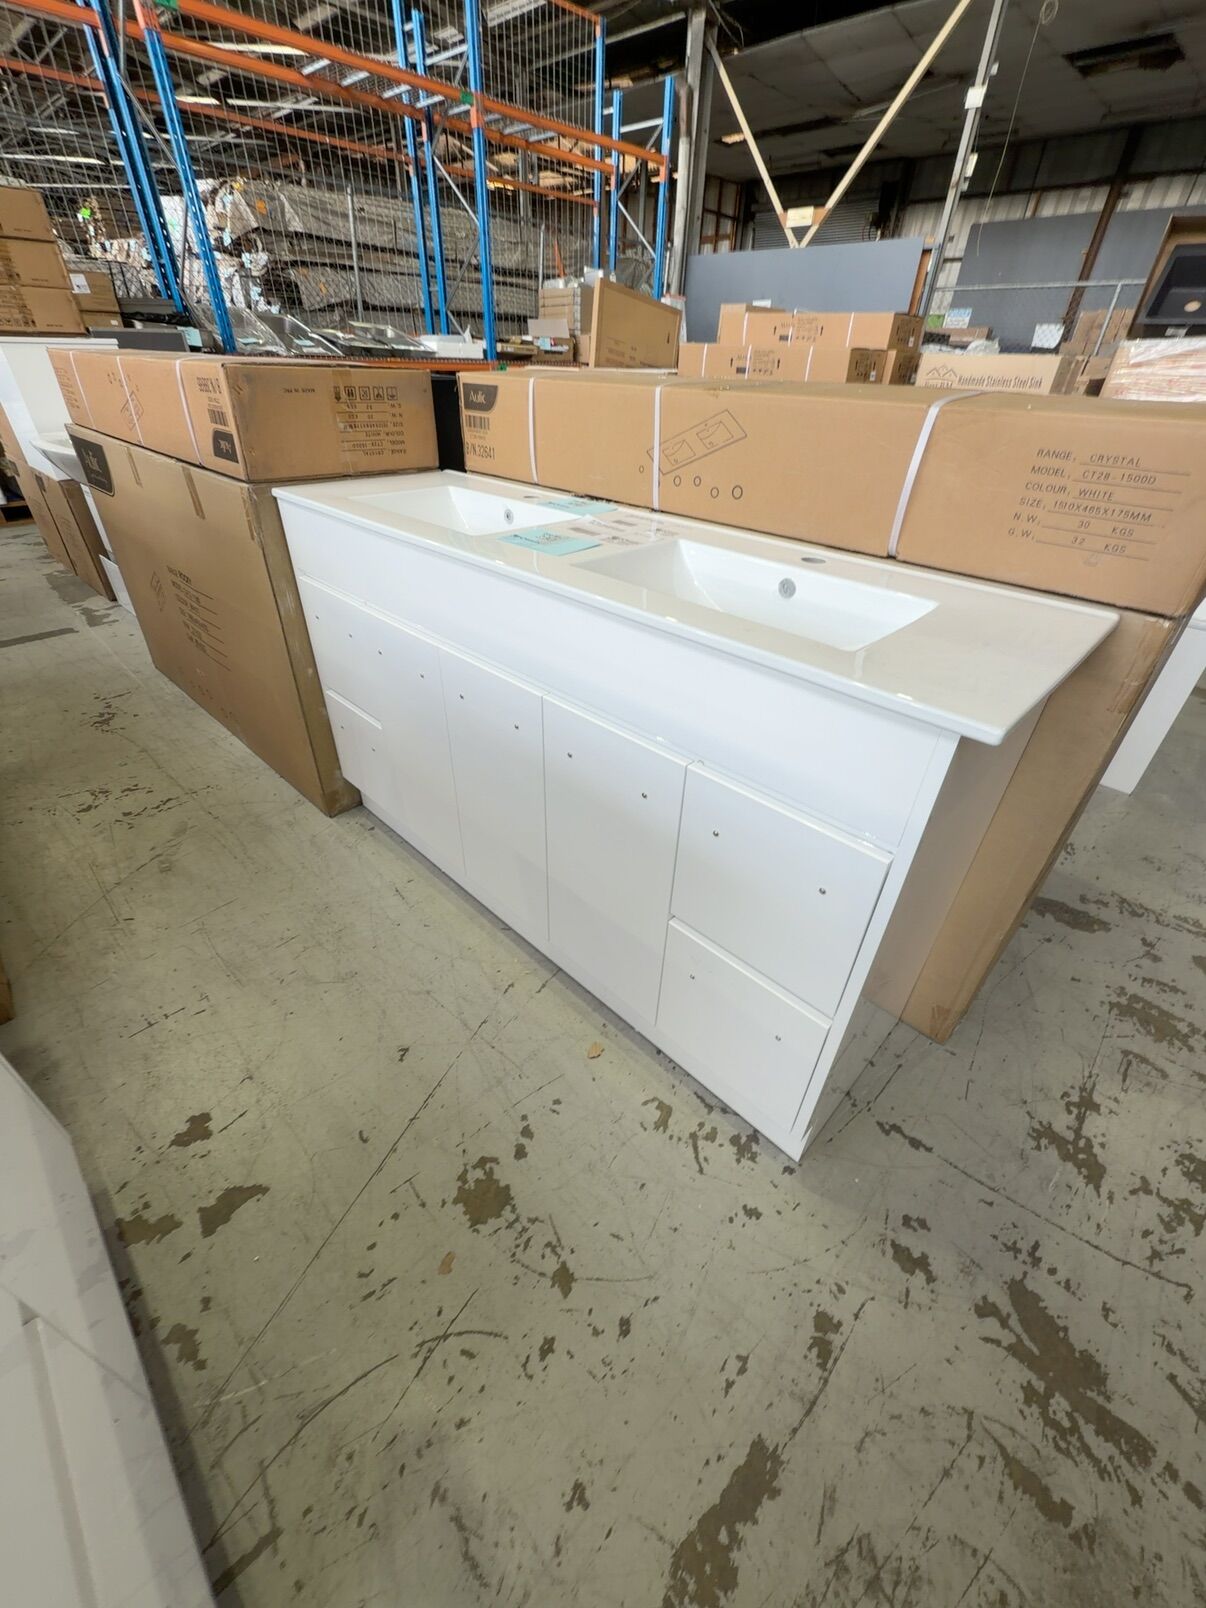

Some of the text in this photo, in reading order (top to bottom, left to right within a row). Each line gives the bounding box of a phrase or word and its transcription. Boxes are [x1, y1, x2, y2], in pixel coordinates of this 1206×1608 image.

[958, 376, 986, 388] Handmade
[986, 376, 1013, 388] Stainless
[1012, 376, 1030, 389] Steel
[1029, 376, 1043, 389] Sink
[1090, 453, 1142, 467] CRYSTAL
[1078, 487, 1116, 502] WHITE
[1077, 520, 1090, 530] 30
[1111, 526, 1135, 538] KGS
[1071, 536, 1085, 545] 32
[1103, 543, 1127, 554] KGS
